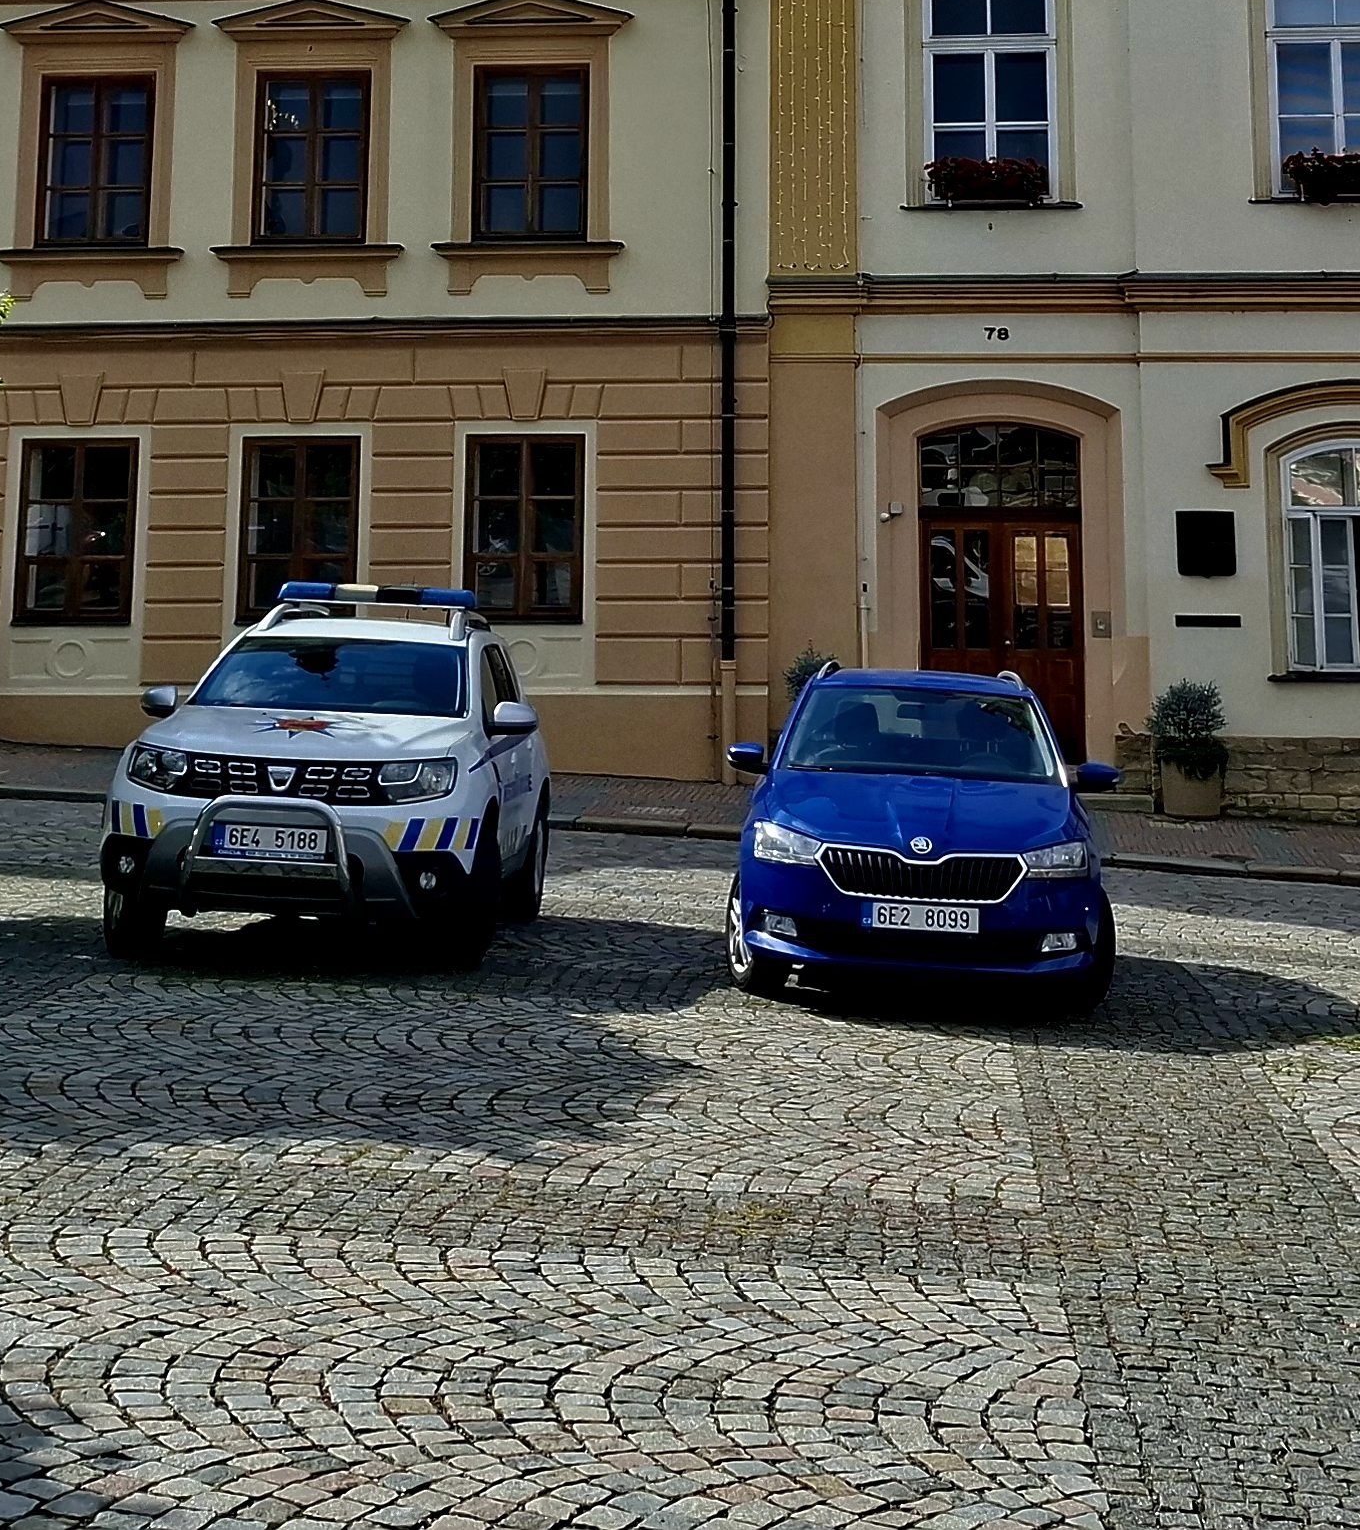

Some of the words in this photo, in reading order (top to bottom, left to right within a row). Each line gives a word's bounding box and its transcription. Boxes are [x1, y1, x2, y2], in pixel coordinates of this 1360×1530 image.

[984, 327, 1009, 341] 78
[229, 828, 261, 848] 6E4
[274, 831, 318, 850] 5188
[877, 906, 911, 926] 6E2
[925, 908, 970, 930] 8099
